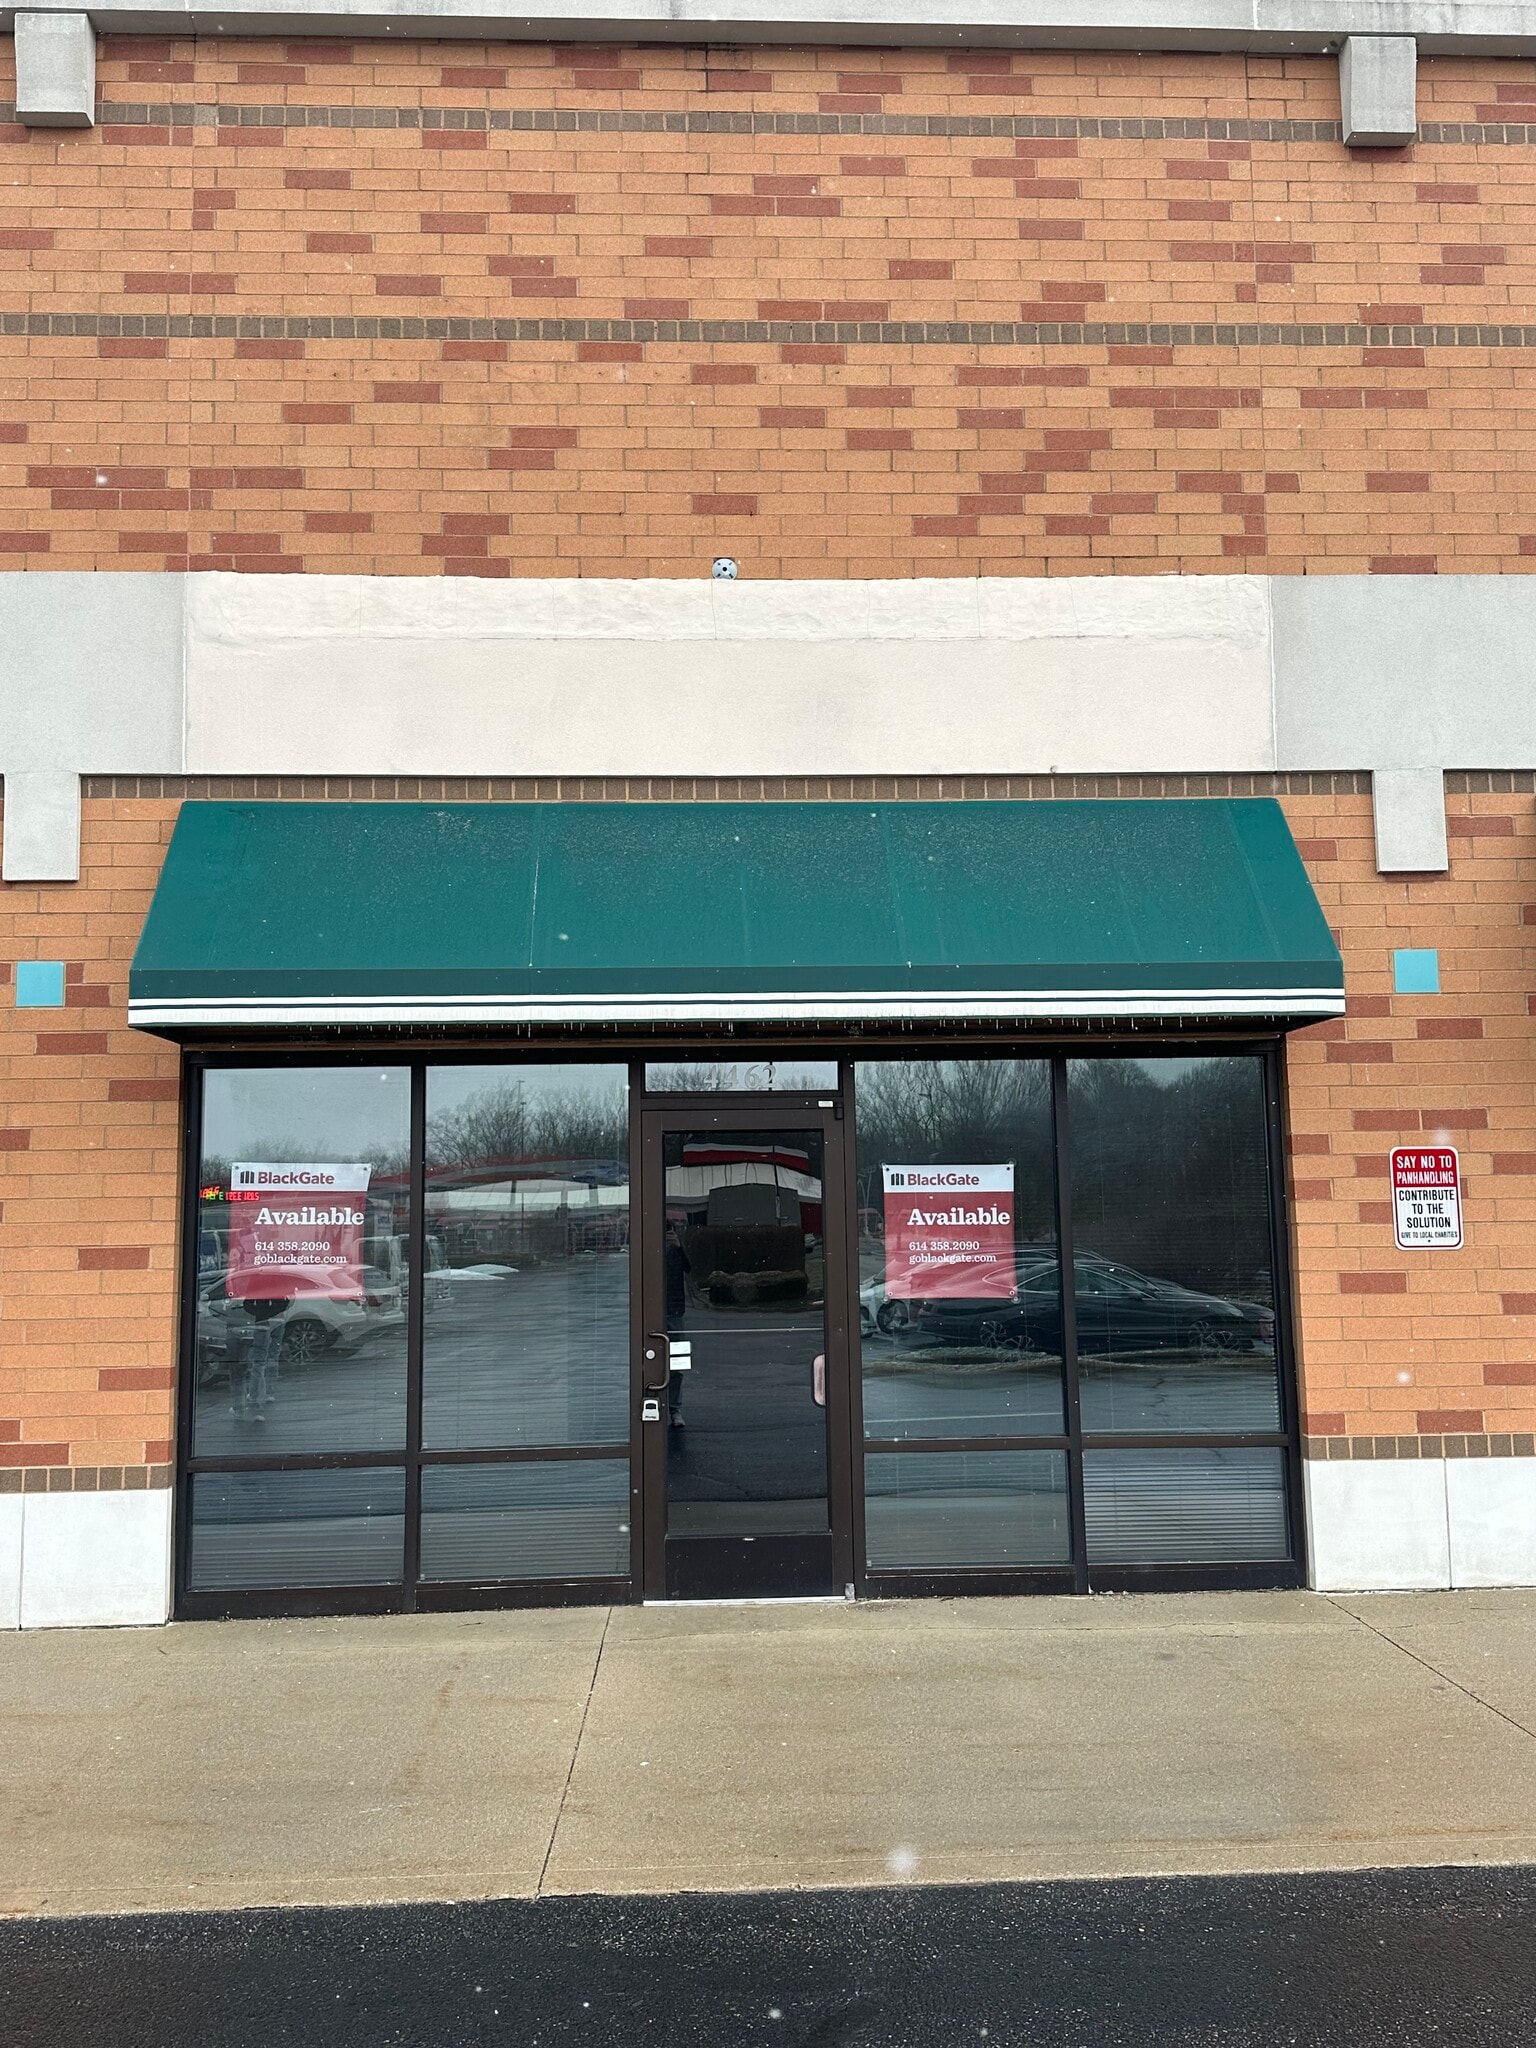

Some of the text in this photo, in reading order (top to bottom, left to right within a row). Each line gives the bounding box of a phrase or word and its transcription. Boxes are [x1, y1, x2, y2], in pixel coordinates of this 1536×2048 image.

[703, 1064, 777, 1090] 4462
[1396, 1155, 1452, 1169] SAY NO TO
[257, 1171, 335, 1185] BlackGate
[907, 1173, 980, 1186] BlackGate
[1396, 1171, 1454, 1184] PANHANDLING
[1398, 1189, 1455, 1201] CONTRIBUTE
[1411, 1203, 1444, 1214] TO THE
[254, 1207, 364, 1225] Available
[907, 1207, 1010, 1226] Available
[1406, 1216, 1451, 1228] SOLUTION
[255, 1241, 330, 1251] 614 358.2090
[909, 1241, 980, 1251] 614 358.2090
[253, 1254, 347, 1265] goblackgate.com
[909, 1253, 997, 1264] goblackgate.com
